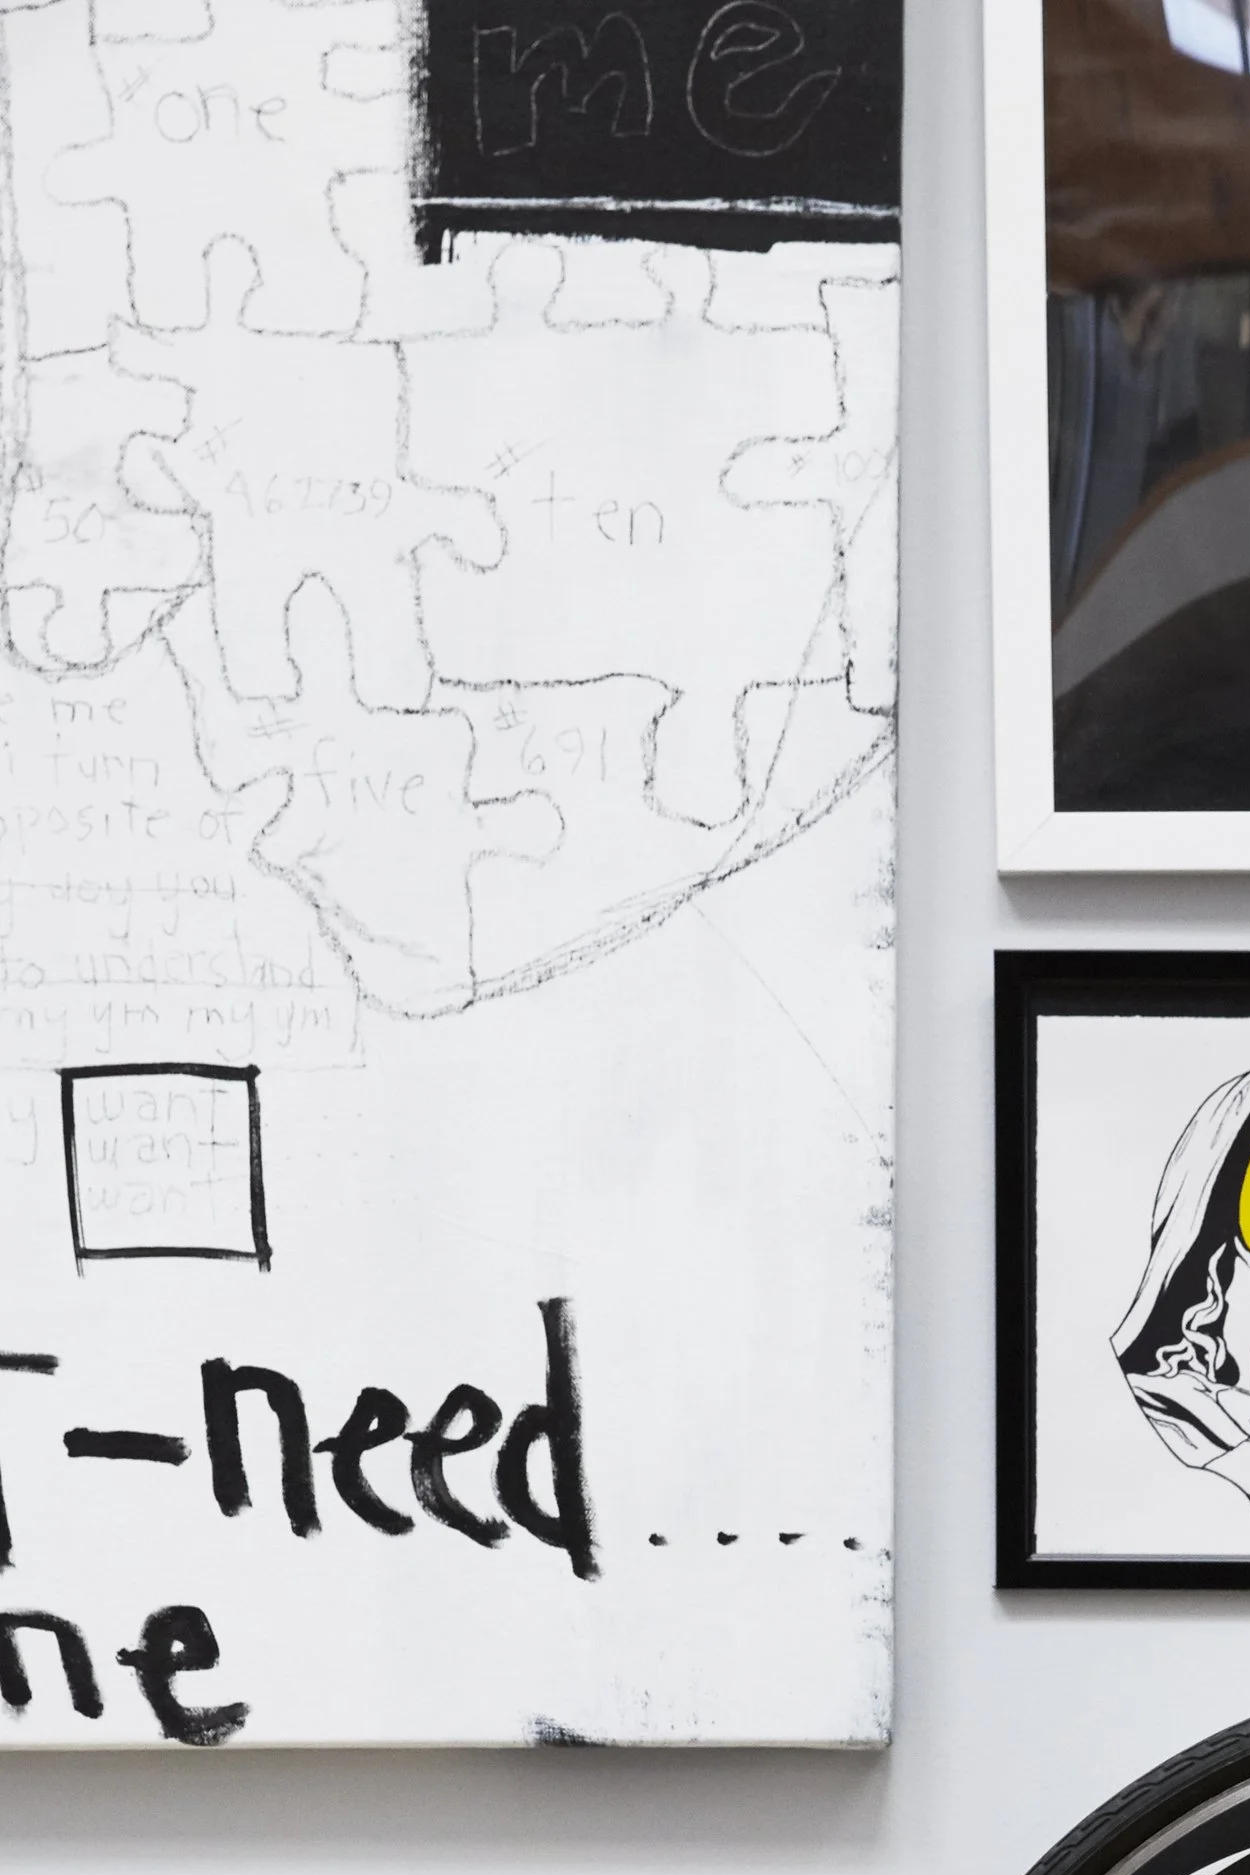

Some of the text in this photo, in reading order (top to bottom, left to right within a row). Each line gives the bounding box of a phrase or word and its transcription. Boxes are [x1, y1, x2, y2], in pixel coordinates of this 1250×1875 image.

[473, 0, 842, 156] me
[154, 82, 288, 145] one
[529, 469, 665, 547] ten
[50, 695, 128, 725] me
[42, 749, 160, 788] turn
[303, 736, 426, 817] five
[86, 1089, 228, 1133] want
[87, 1131, 239, 1170] want
